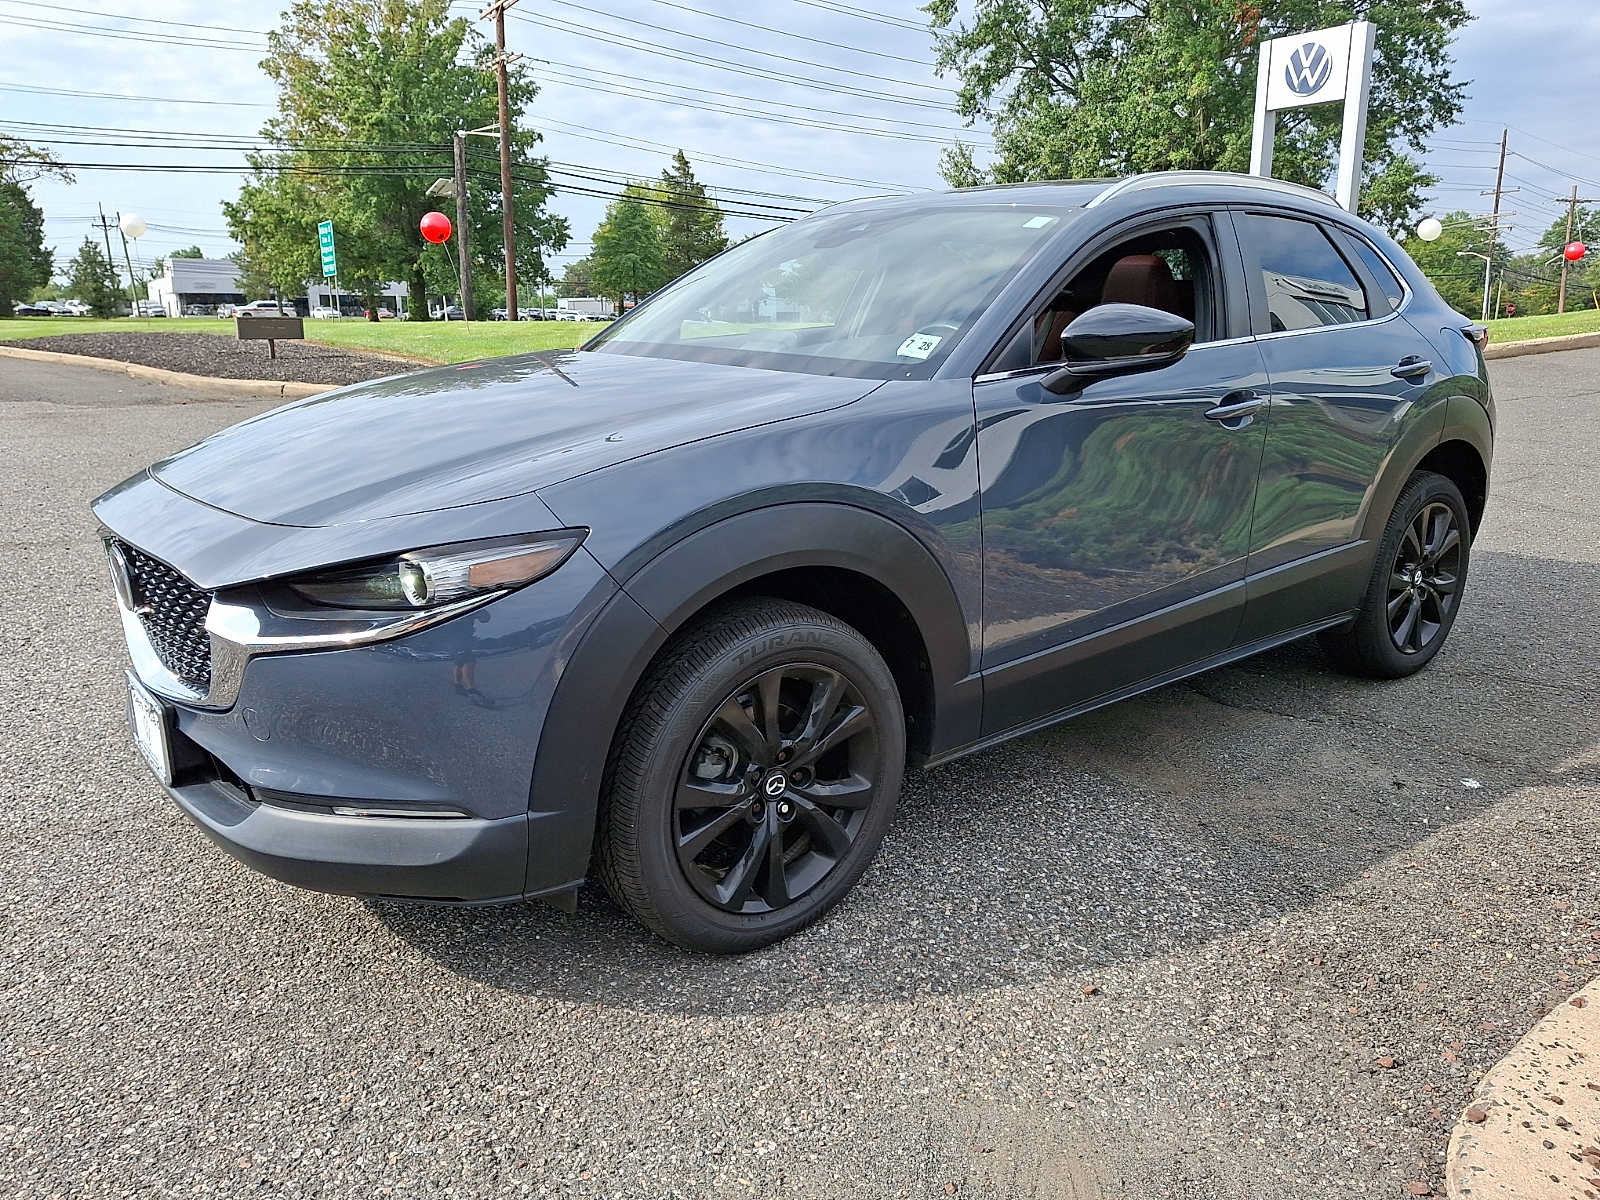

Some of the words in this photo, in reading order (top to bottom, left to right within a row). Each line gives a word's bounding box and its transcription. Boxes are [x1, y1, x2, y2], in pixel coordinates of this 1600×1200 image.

[1286, 42, 1332, 96] VW
[905, 339, 916, 348] 7
[731, 630, 845, 667] TURANZ
